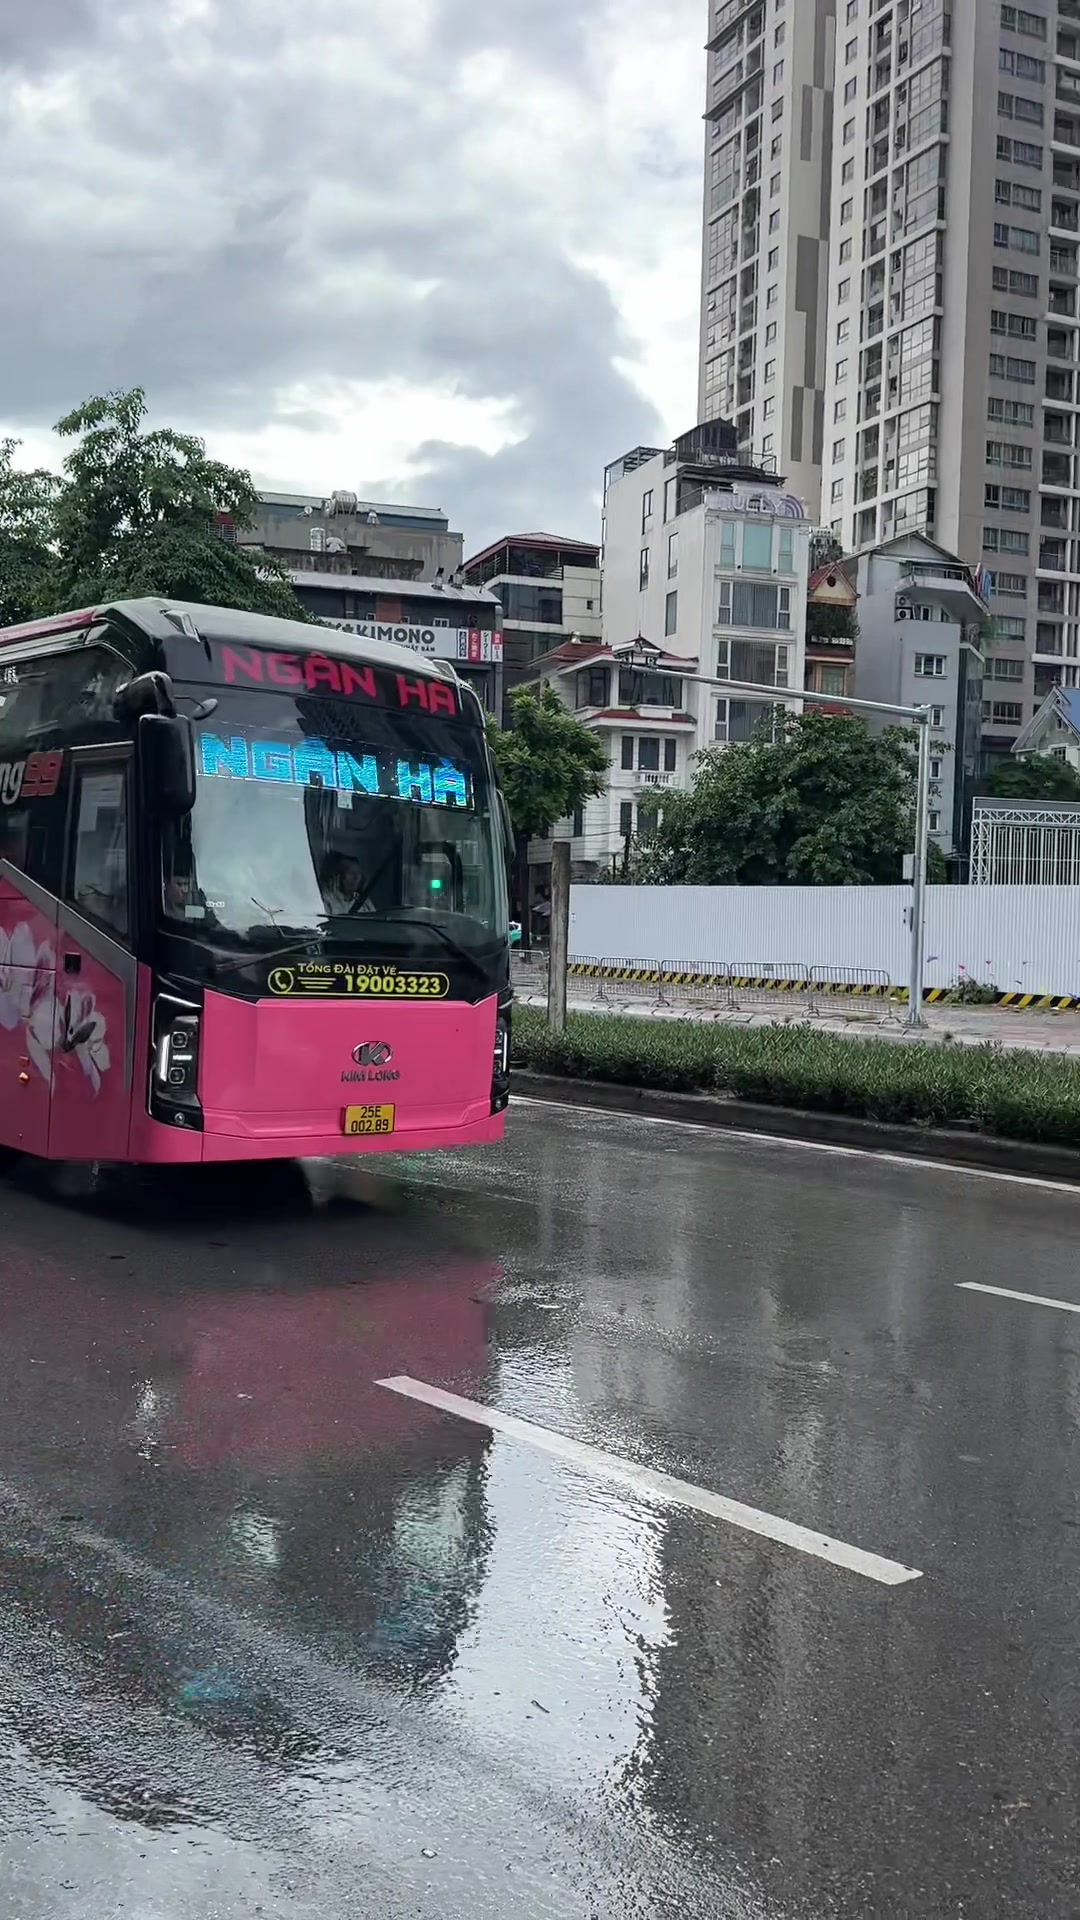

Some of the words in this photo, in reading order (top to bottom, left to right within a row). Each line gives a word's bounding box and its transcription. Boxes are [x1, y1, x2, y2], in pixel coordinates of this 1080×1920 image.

[356, 624, 435, 644] KIMONO
[221, 646, 376, 697] NGÂN
[397, 673, 457, 715] HÀ
[201, 733, 380, 793] NGÂN
[397, 755, 466, 806] HÀ
[345, 975, 441, 993] 19003323
[360, 1105, 382, 1119] 25E
[350, 1119, 389, 1132] 002.89
